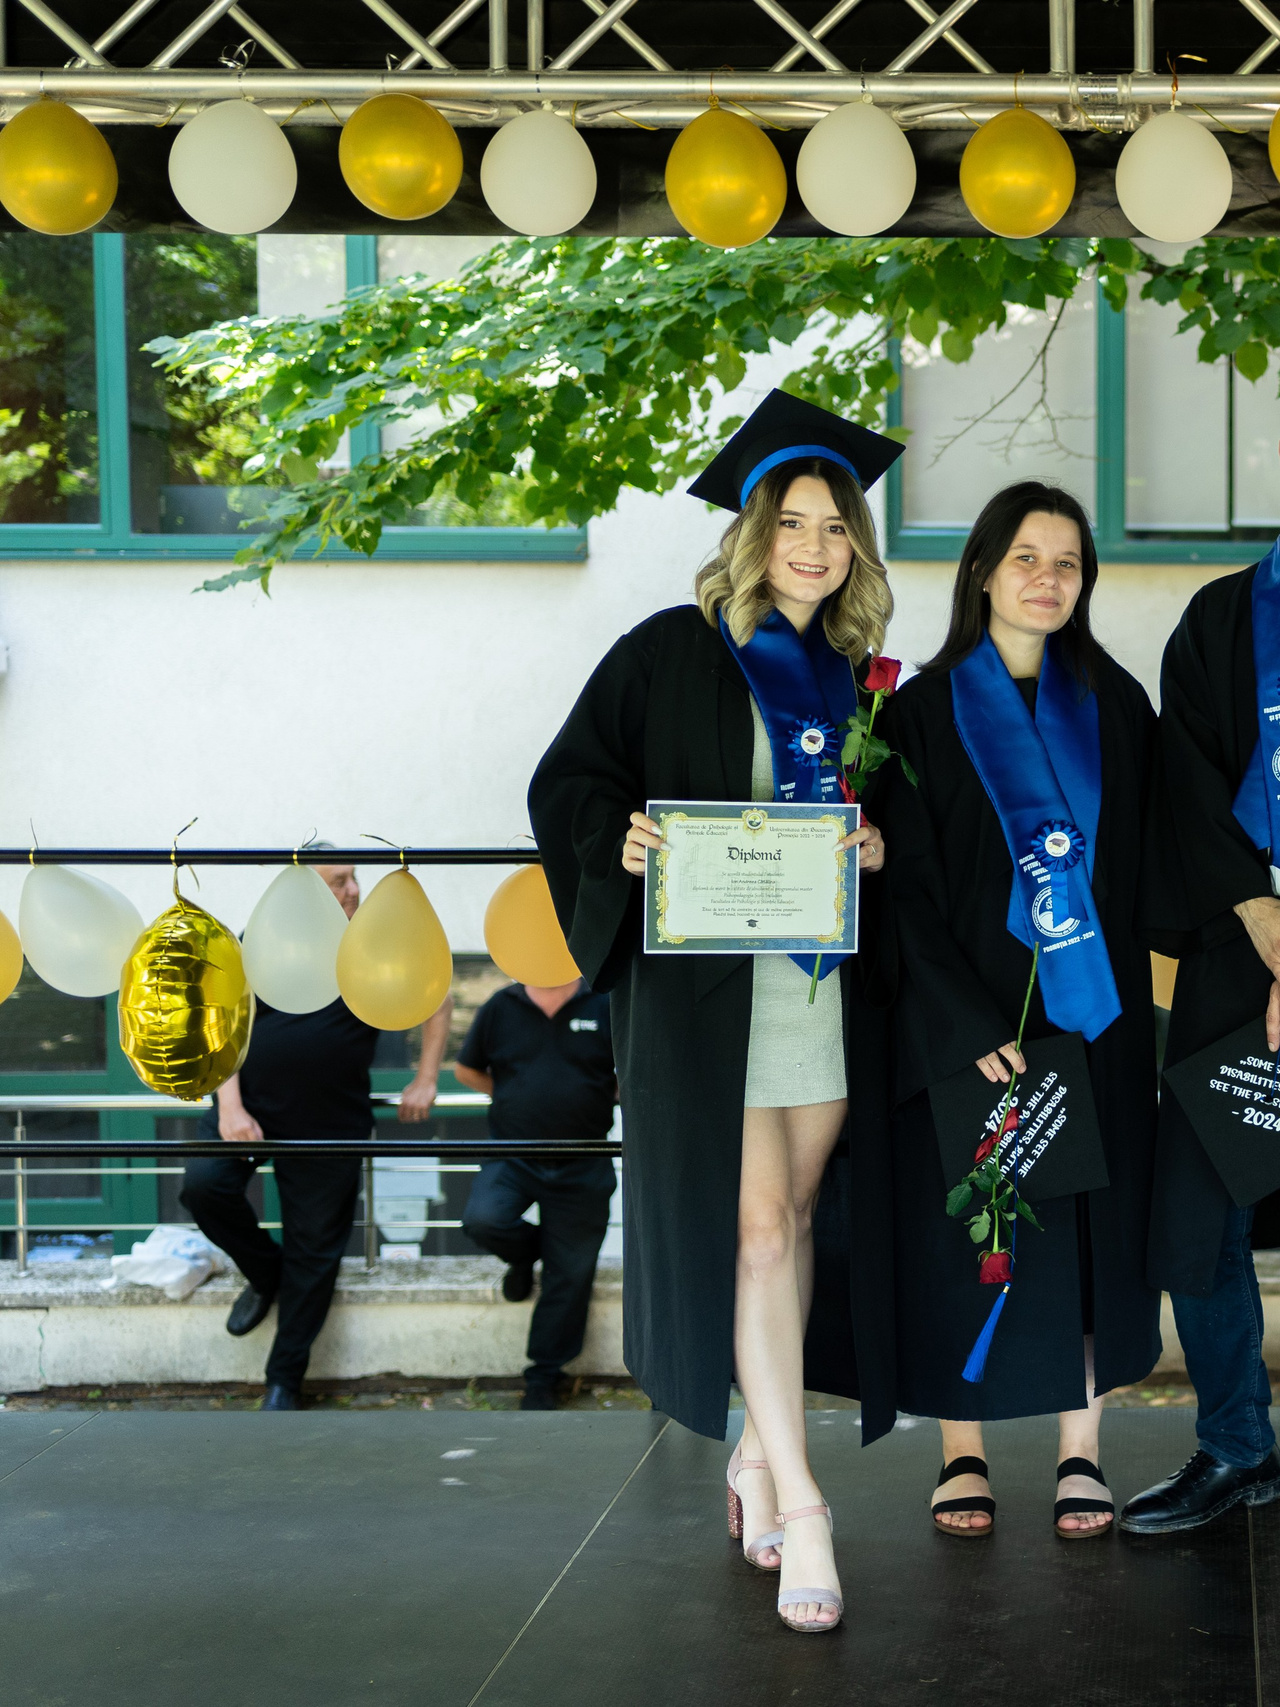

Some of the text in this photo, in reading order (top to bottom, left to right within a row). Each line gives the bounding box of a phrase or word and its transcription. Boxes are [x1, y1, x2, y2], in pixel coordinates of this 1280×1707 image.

[726, 846, 782, 864] Diplomă
[1026, 1071, 1058, 1111] SEE THE
[1209, 1079, 1231, 1093] SEE
[1232, 1085, 1253, 1099] THE
[1019, 1085, 1067, 1145] DISABILITIES,
[1006, 1144, 1024, 1168] BUT
[1031, 1138, 1049, 1159] SEE
[1017, 1157, 1036, 1178] THE
